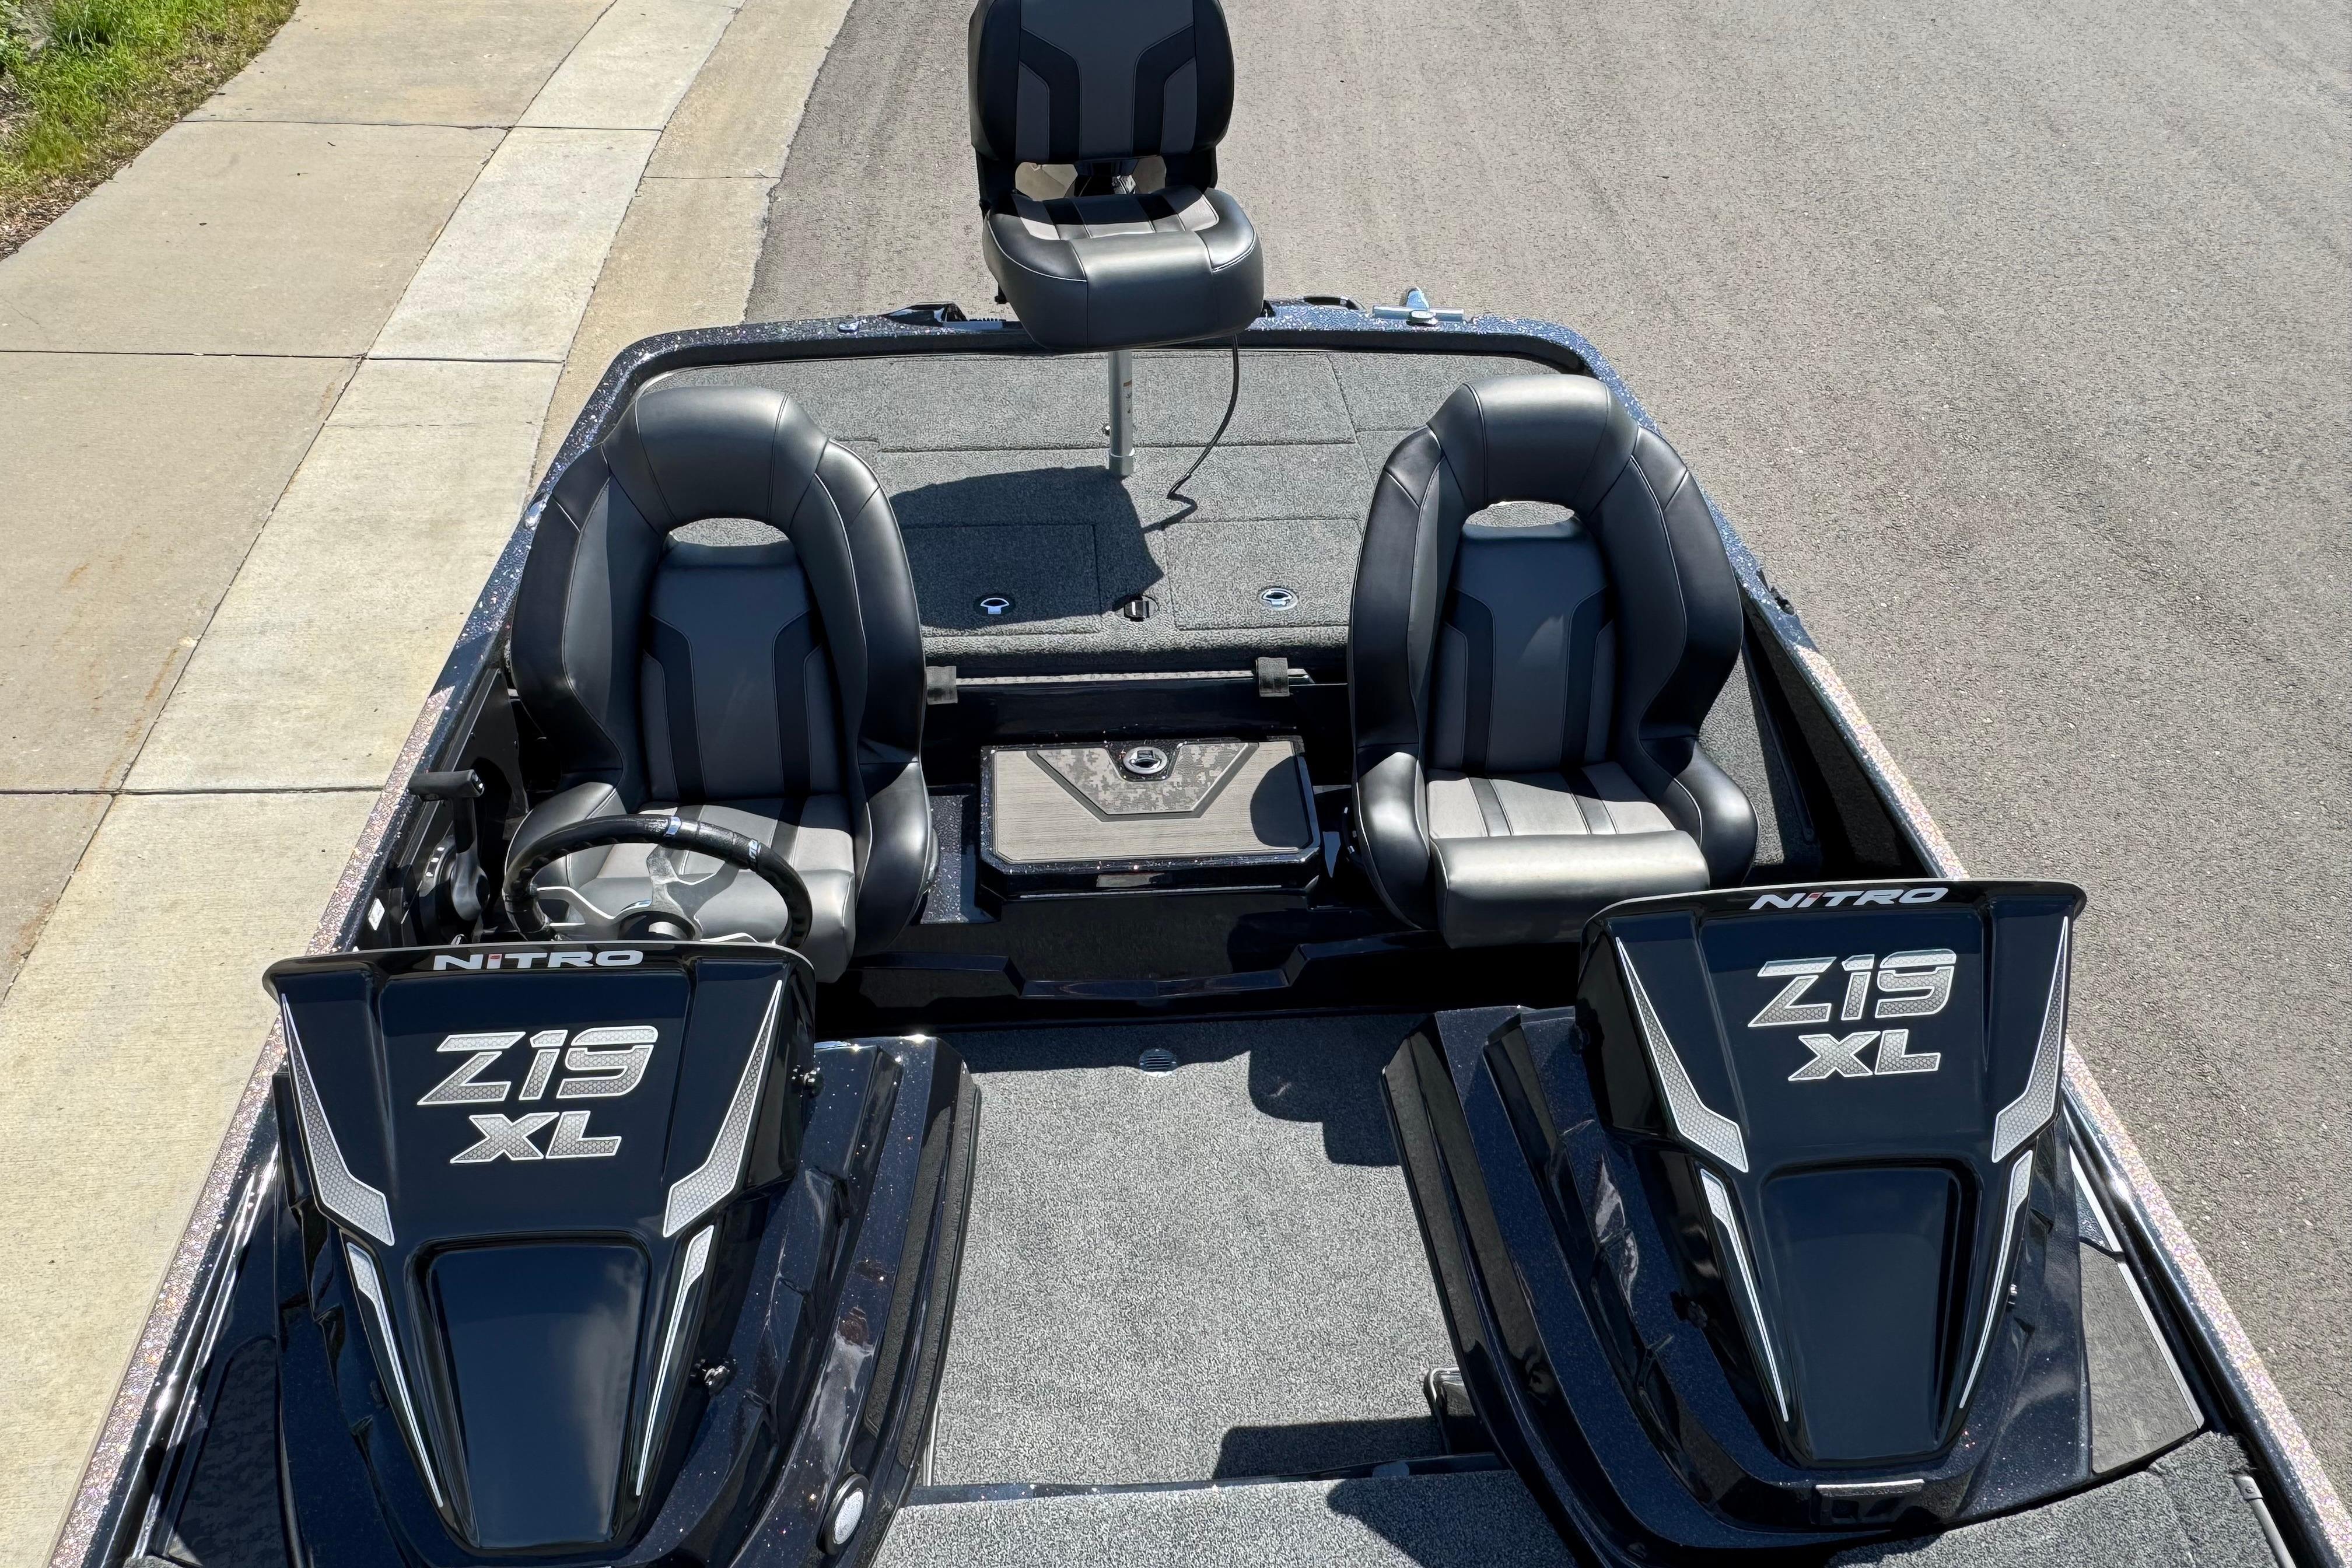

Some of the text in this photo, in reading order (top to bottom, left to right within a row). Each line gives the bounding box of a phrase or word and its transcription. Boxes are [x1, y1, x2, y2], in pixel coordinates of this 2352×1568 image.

[1748, 948, 1957, 1028] Z19
[416, 1025, 659, 1106] Z19
[1787, 1028, 1941, 1082] XL
[449, 1110, 622, 1164] XL
